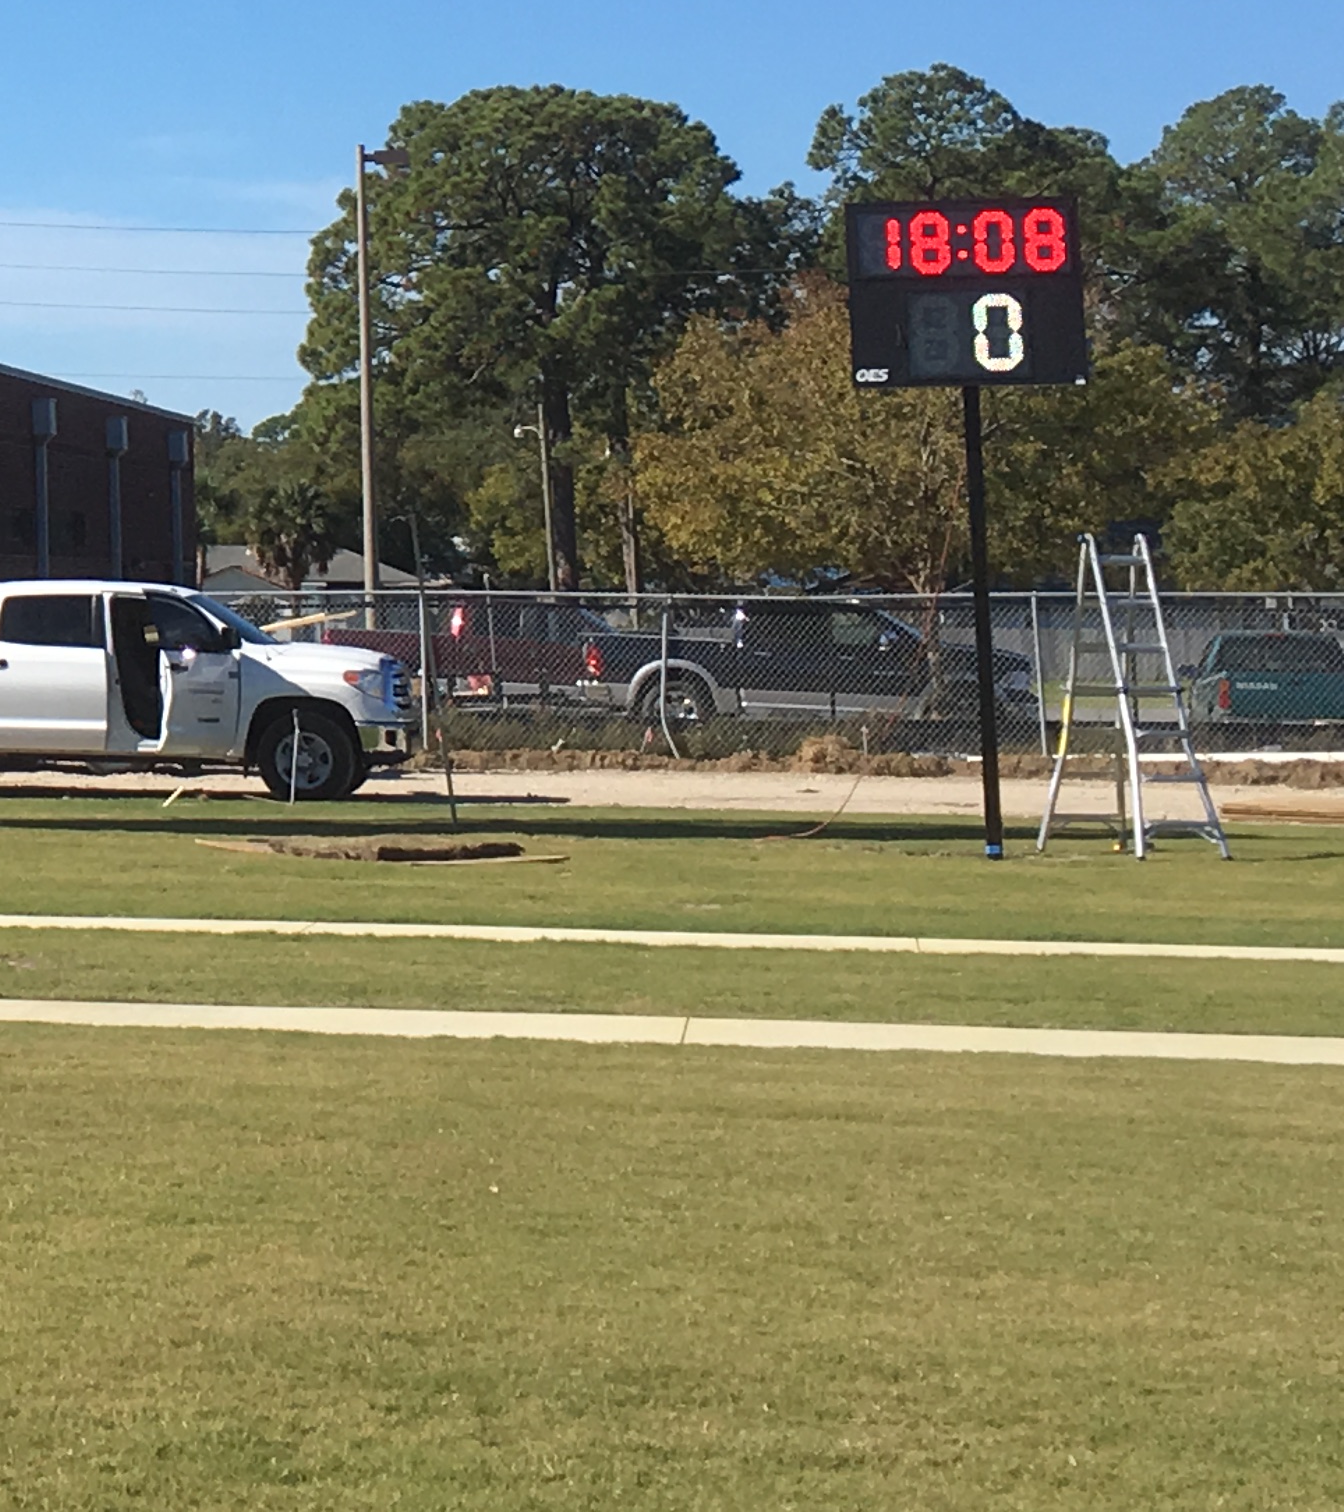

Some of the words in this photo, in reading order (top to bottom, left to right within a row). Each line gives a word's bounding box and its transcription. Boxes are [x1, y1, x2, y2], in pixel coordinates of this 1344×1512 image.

[884, 207, 1067, 275] 18:08
[972, 292, 1025, 372] 0
[855, 368, 889, 382] OES
